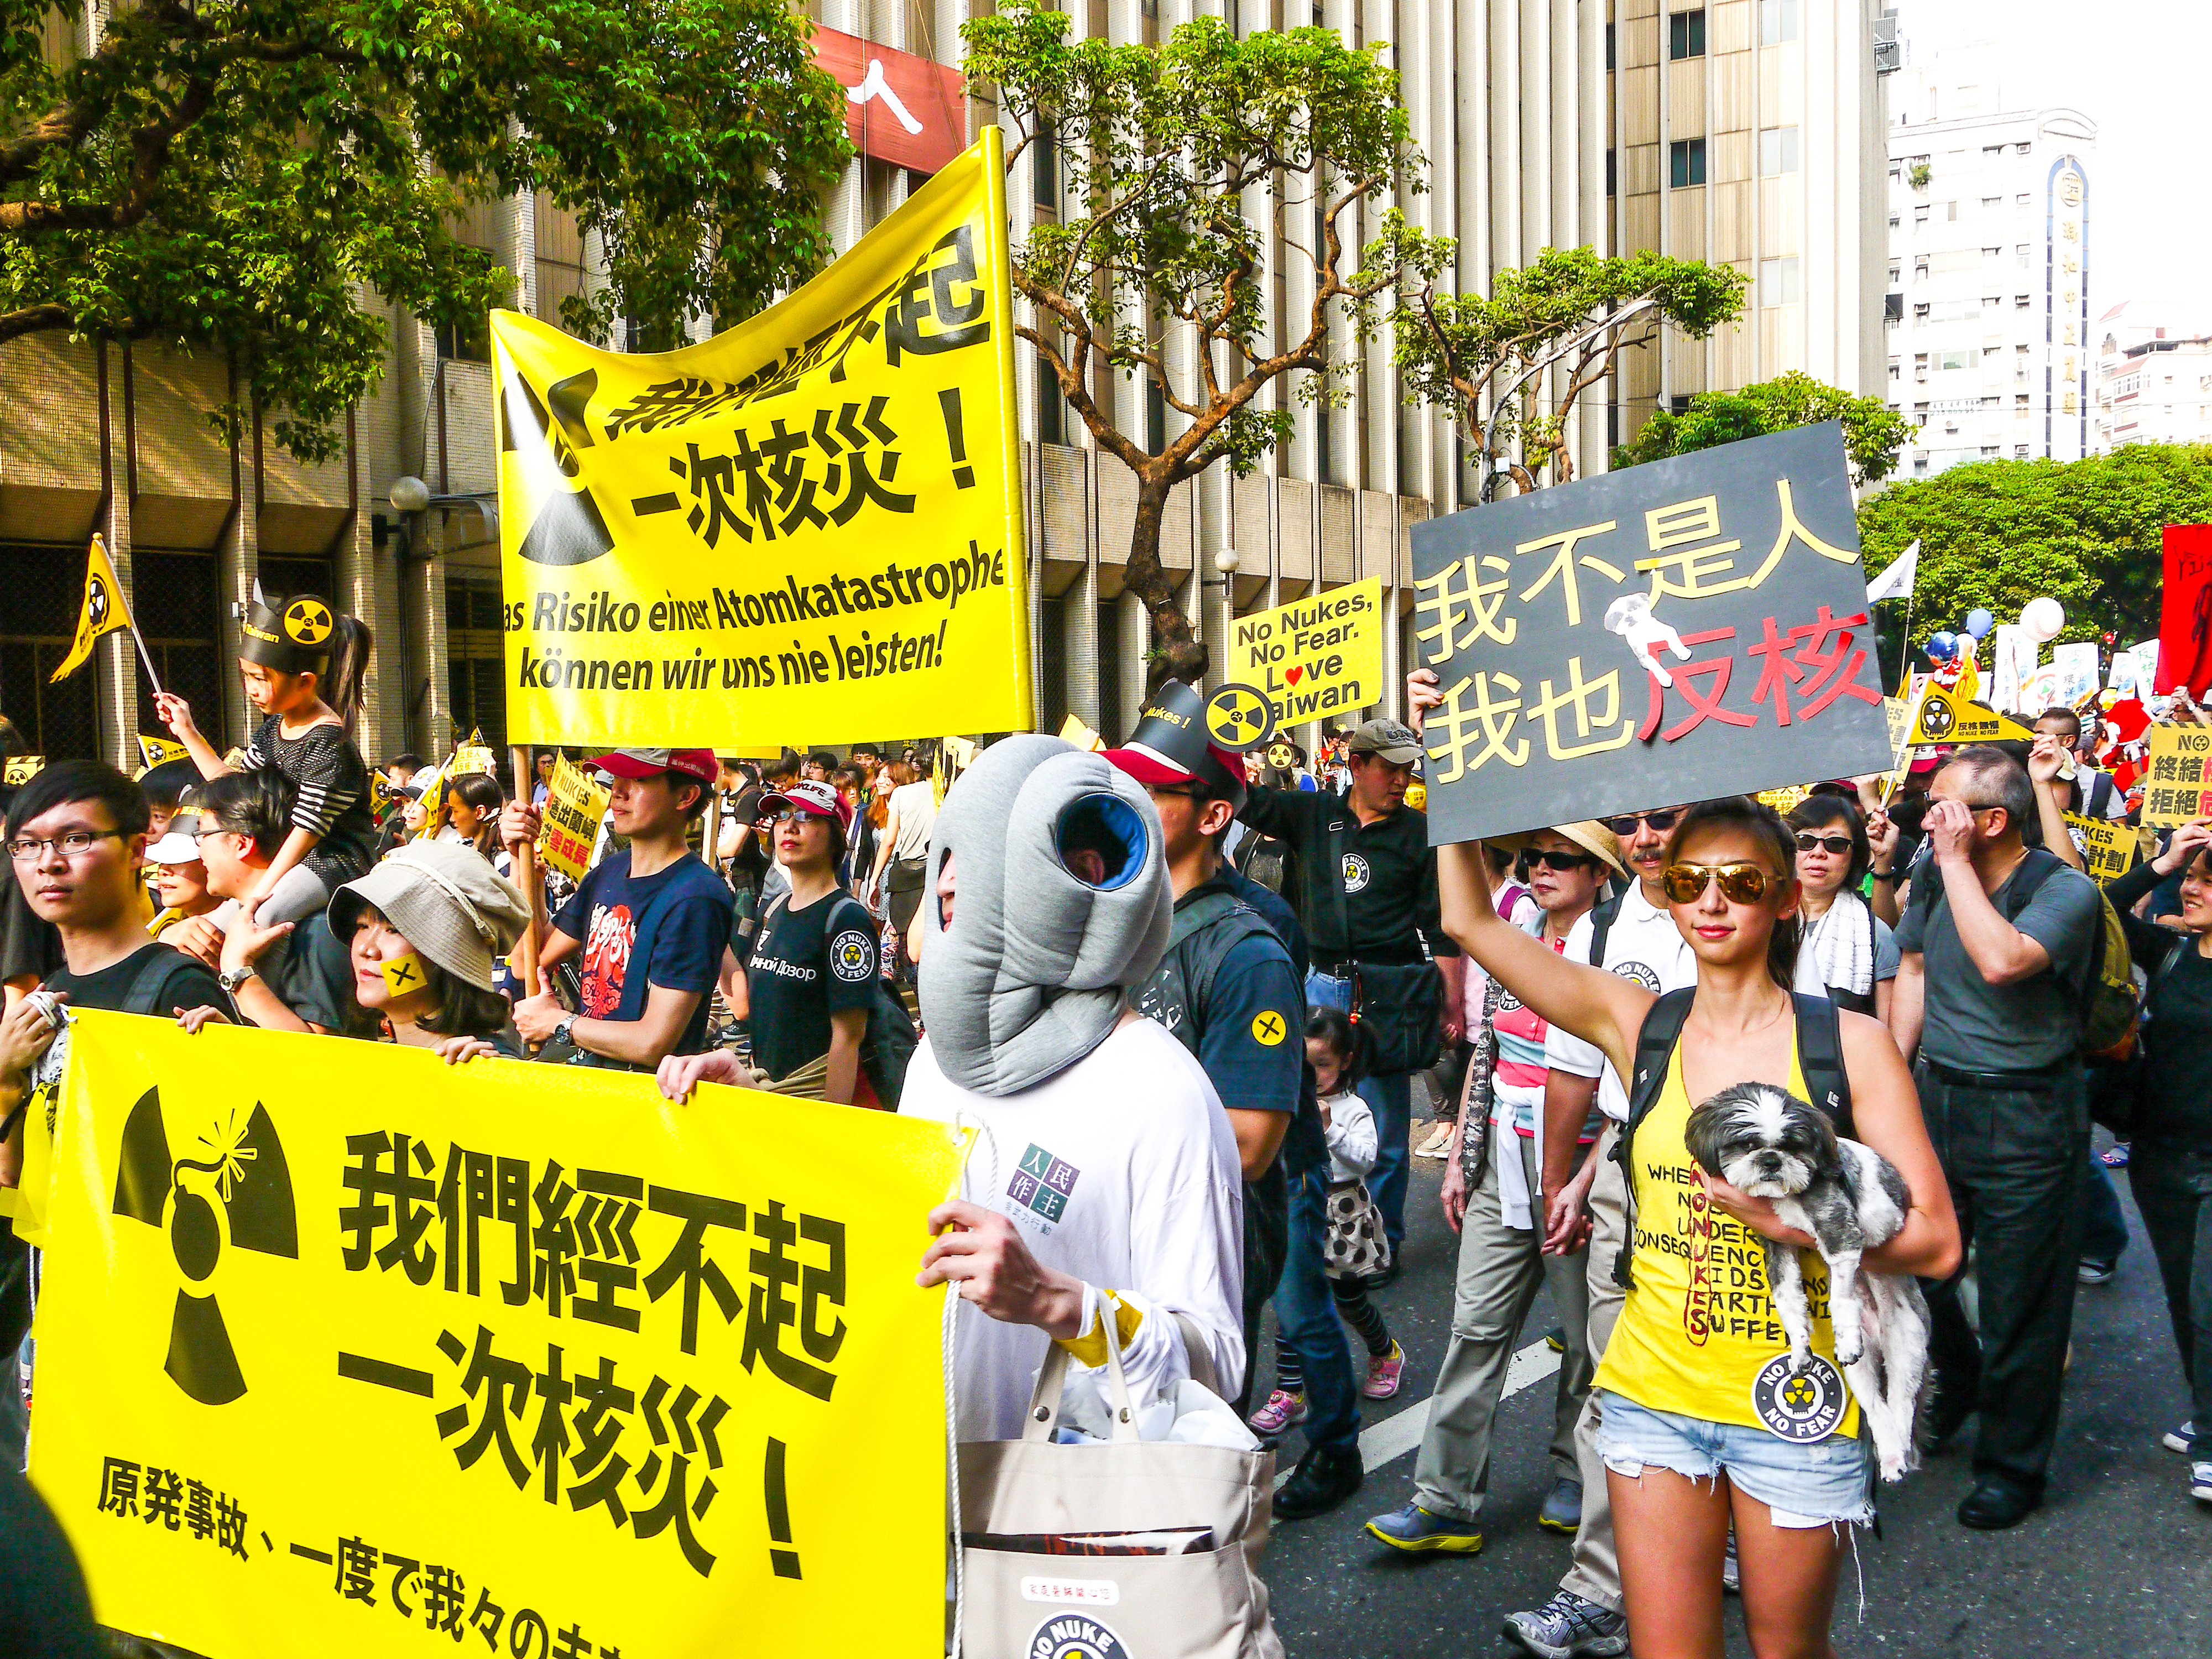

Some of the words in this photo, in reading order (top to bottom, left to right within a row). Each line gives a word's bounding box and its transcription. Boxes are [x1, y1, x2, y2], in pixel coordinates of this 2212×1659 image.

[533, 592, 640, 633] Risiko
[648, 591, 709, 632] einer
[717, 540, 1004, 628] Atomkatastrophe
[1414, 478, 1860, 665] 我不是人
[1238, 622, 1272, 647] No
[1281, 594, 1373, 634] Nukes,
[519, 646, 654, 690] können
[662, 647, 716, 690] wir
[721, 656, 774, 689] uns
[783, 638, 829, 686] nie
[829, 619, 947, 681] leisten!
[1250, 643, 1285, 668] No
[1295, 622, 1359, 656] Fear.
[1273, 680, 1360, 721] aiwan
[1424, 605, 1884, 784] 我也反核
[557, 773, 591, 807] NUKES
[1349, 856, 1367, 872] NUKE
[835, 937, 846, 951] NO
[848, 934, 871, 953] NUKE
[835, 963, 845, 975] NO
[847, 964, 870, 979] FEAR
[1615, 963, 1632, 975] NO
[1634, 963, 1660, 992] NUKE
[338, 1129, 848, 1403] 我們經不起
[1691, 1308, 1791, 1347] SUFFE
[1761, 1364, 1785, 1387] NO
[1764, 1407, 1790, 1432] NO
[1795, 1405, 1837, 1437] FEAR
[1049, 1619, 1115, 1653] NUKE
